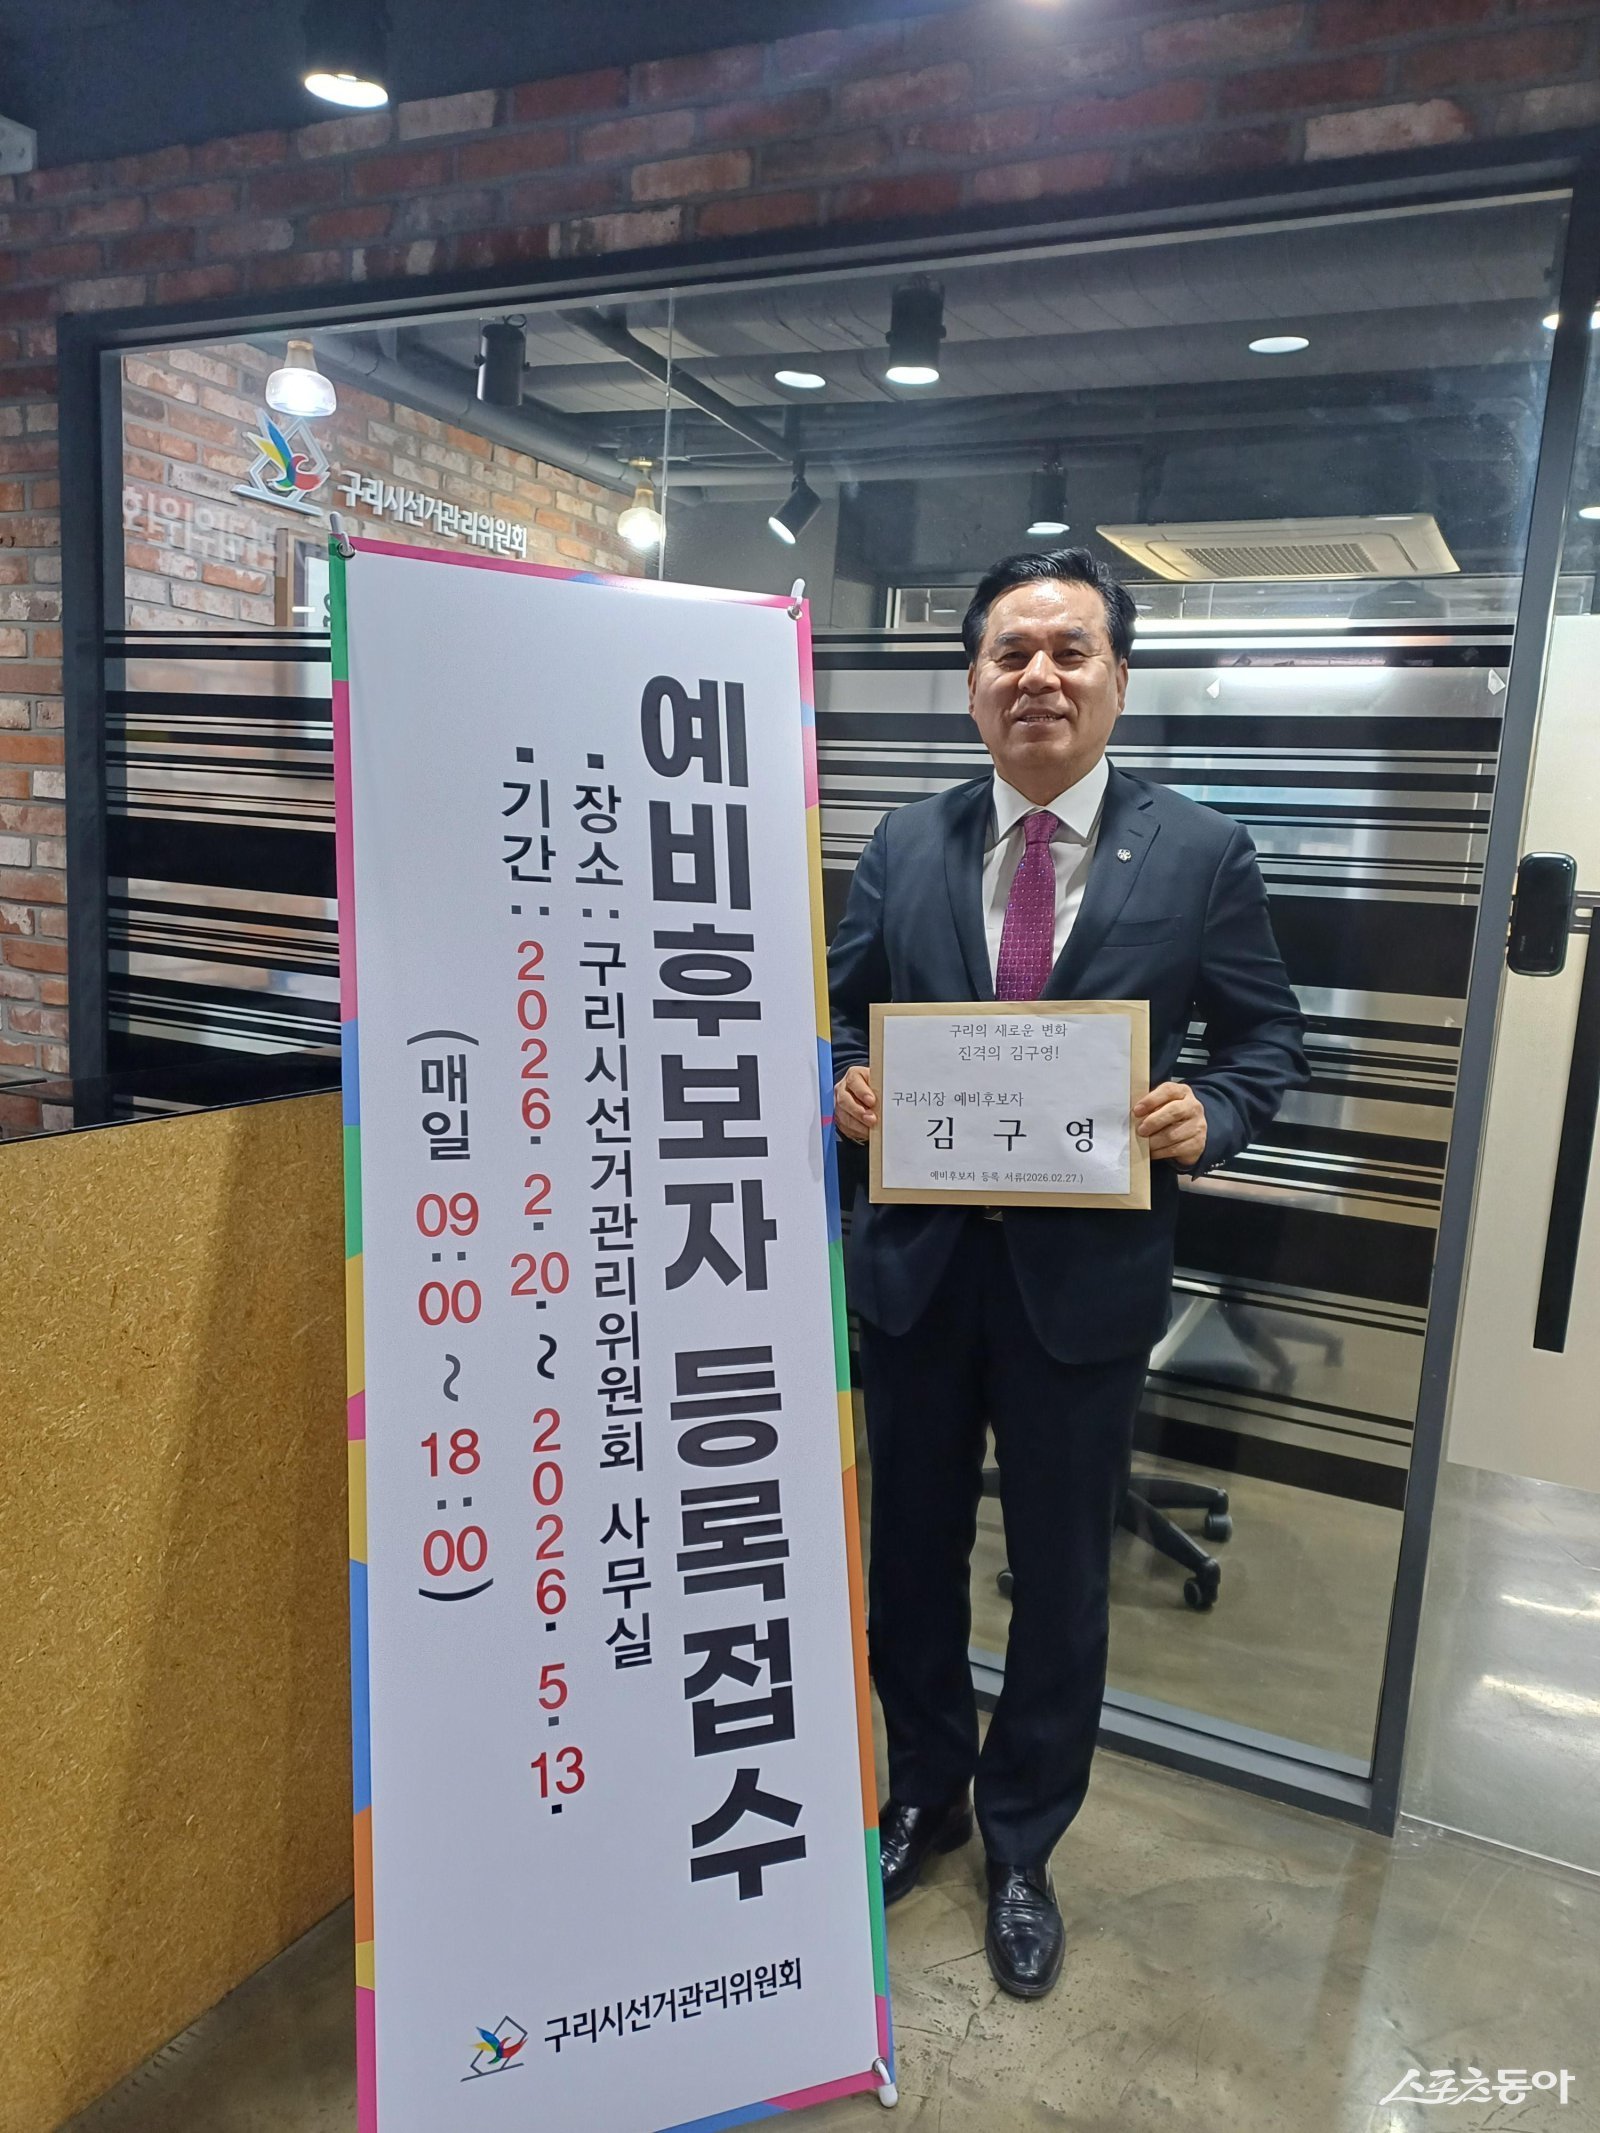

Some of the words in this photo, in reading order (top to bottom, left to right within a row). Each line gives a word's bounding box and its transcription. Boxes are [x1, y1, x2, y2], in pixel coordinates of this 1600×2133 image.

[337, 470, 527, 558] 구리시선거관리위원회
[641, 675, 778, 1291] 예비후보자
[949, 1023, 988, 1038] 구리의
[994, 1022, 1034, 1038] 새로운
[1041, 1022, 1068, 1038] 변화
[958, 1046, 1001, 1061] 진격의
[1010, 1045, 1060, 1061] 김구영!
[891, 1091, 947, 1107] 구리시장
[953, 1091, 1024, 1107] 예비후보자
[930, 1171, 975, 1182] 예비후보자
[981, 1171, 1000, 1182] 등록
[600, 1497, 652, 1671] 사무실
[670, 1345, 807, 1901] 등록접수
[544, 1957, 803, 2053] 구리시선거관리위원회
